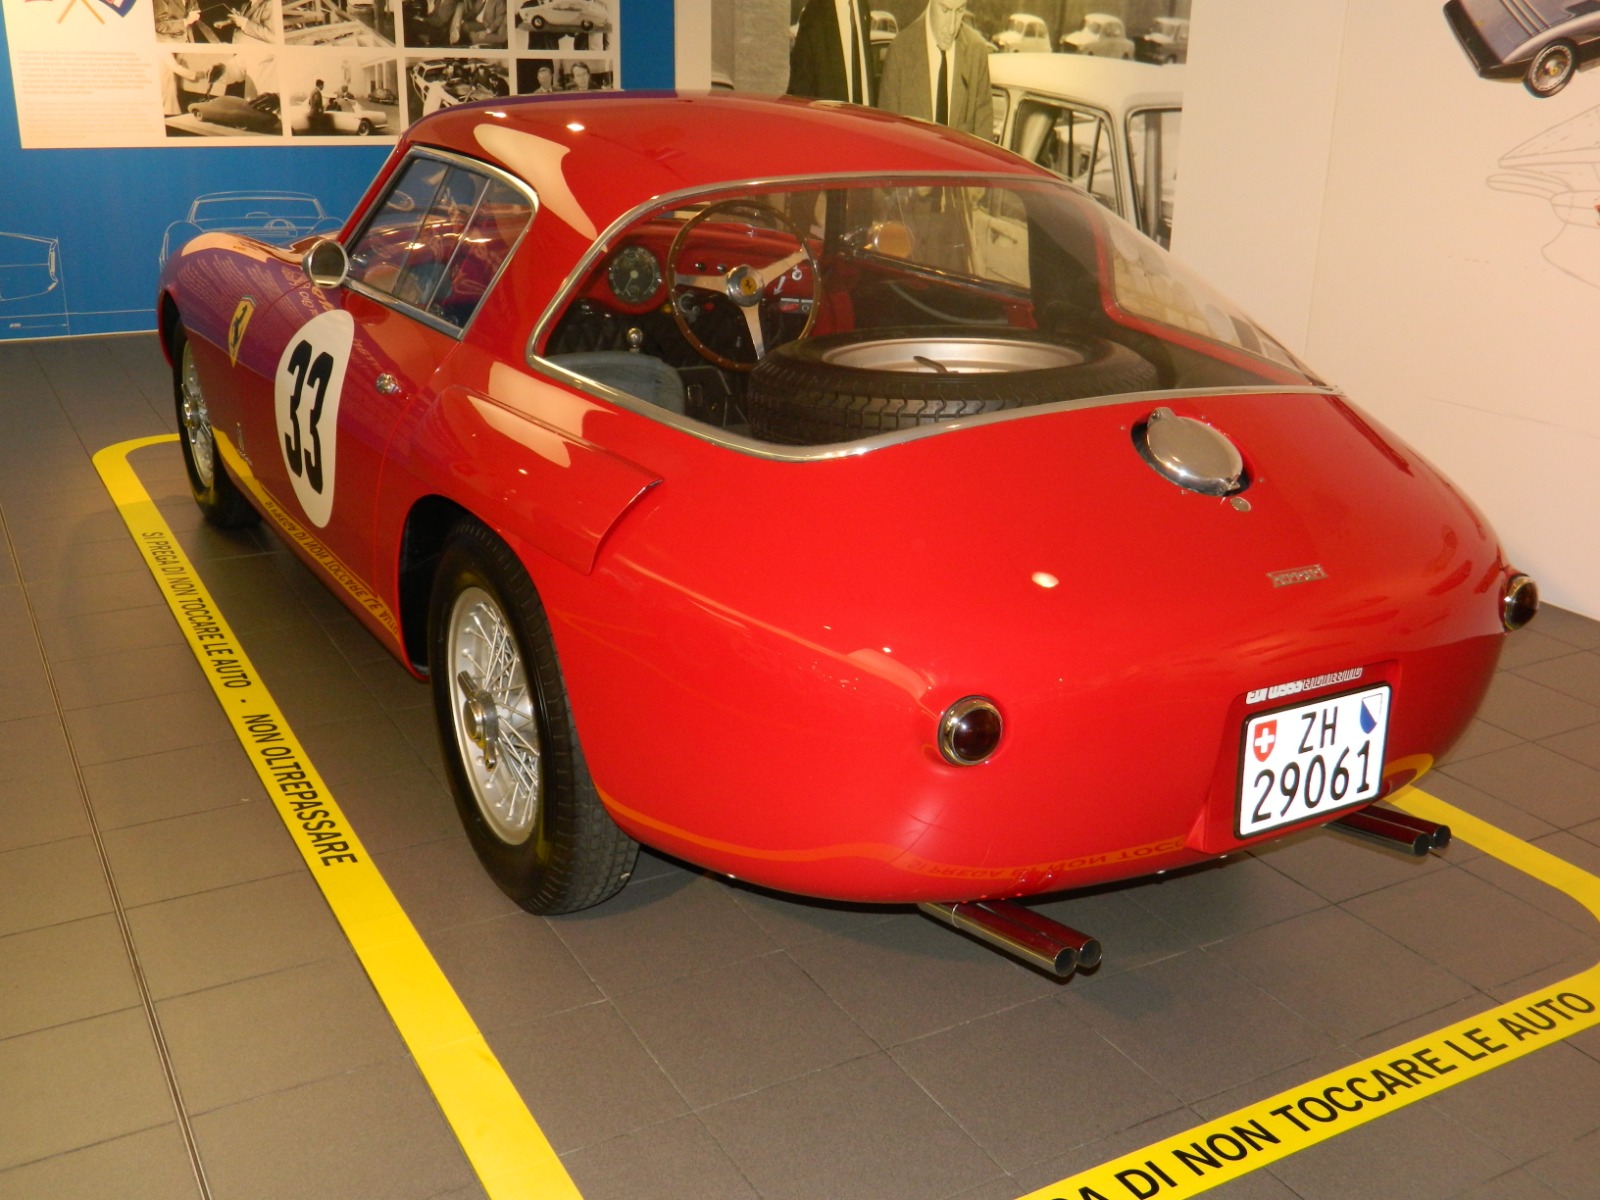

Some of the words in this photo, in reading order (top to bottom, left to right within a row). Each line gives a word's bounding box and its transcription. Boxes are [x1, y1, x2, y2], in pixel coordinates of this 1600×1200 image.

[284, 339, 334, 495] 33
[147, 541, 180, 566] PREGA
[161, 567, 187, 575] DI
[166, 577, 198, 596] NON
[179, 598, 224, 641] TOCCARE
[203, 643, 234, 657] LE
[211, 660, 252, 689] AUTO
[241, 714, 285, 743] NON
[1298, 706, 1338, 754] ZH
[1251, 740, 1370, 824] 29061
[260, 746, 358, 867] OLTREPASSARE
[1114, 1160, 1178, 1200] DI
[1171, 1118, 1282, 1177] NON
[1269, 1048, 1458, 1133] TOCCARE
[1442, 1027, 1509, 1062] LE
[1497, 991, 1597, 1042] AUTO
